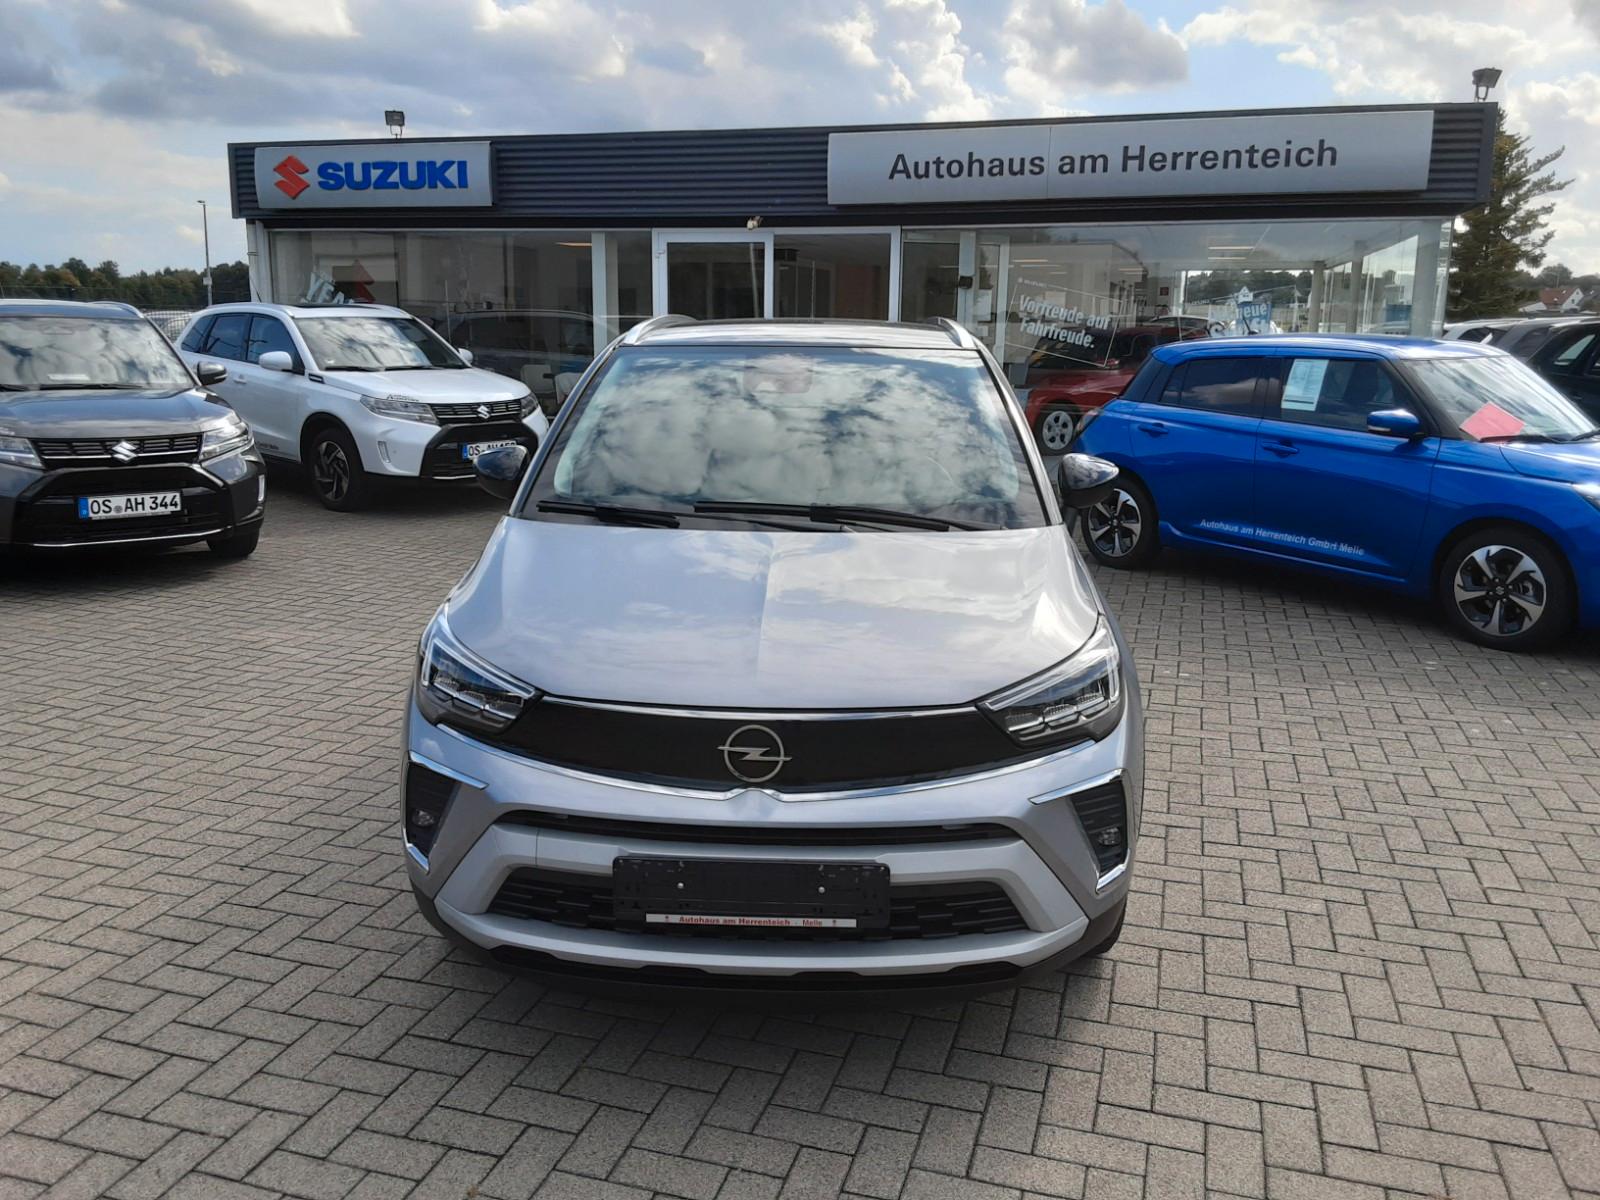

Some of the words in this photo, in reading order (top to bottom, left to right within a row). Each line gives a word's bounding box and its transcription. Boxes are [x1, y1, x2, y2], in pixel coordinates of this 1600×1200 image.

[317, 159, 468, 190] SUZUKI
[888, 151, 1046, 181] Autohaus
[1057, 152, 1110, 174] am
[1122, 138, 1338, 173] Herrenteich
[1019, 295, 1084, 323] Vorfreude
[1087, 315, 1111, 330] auf
[1019, 317, 1095, 348] Fahrfreude.
[90, 499, 112, 515] OS
[125, 497, 146, 512] AH
[149, 495, 178, 510] 344
[1200, 519, 1239, 532] Autohaus
[1240, 526, 1254, 536] am
[1255, 529, 1306, 545] Herrenteich
[678, 916, 720, 925] Autohaus
[738, 917, 791, 926] Herrenteich
[802, 919, 823, 927] Melle
